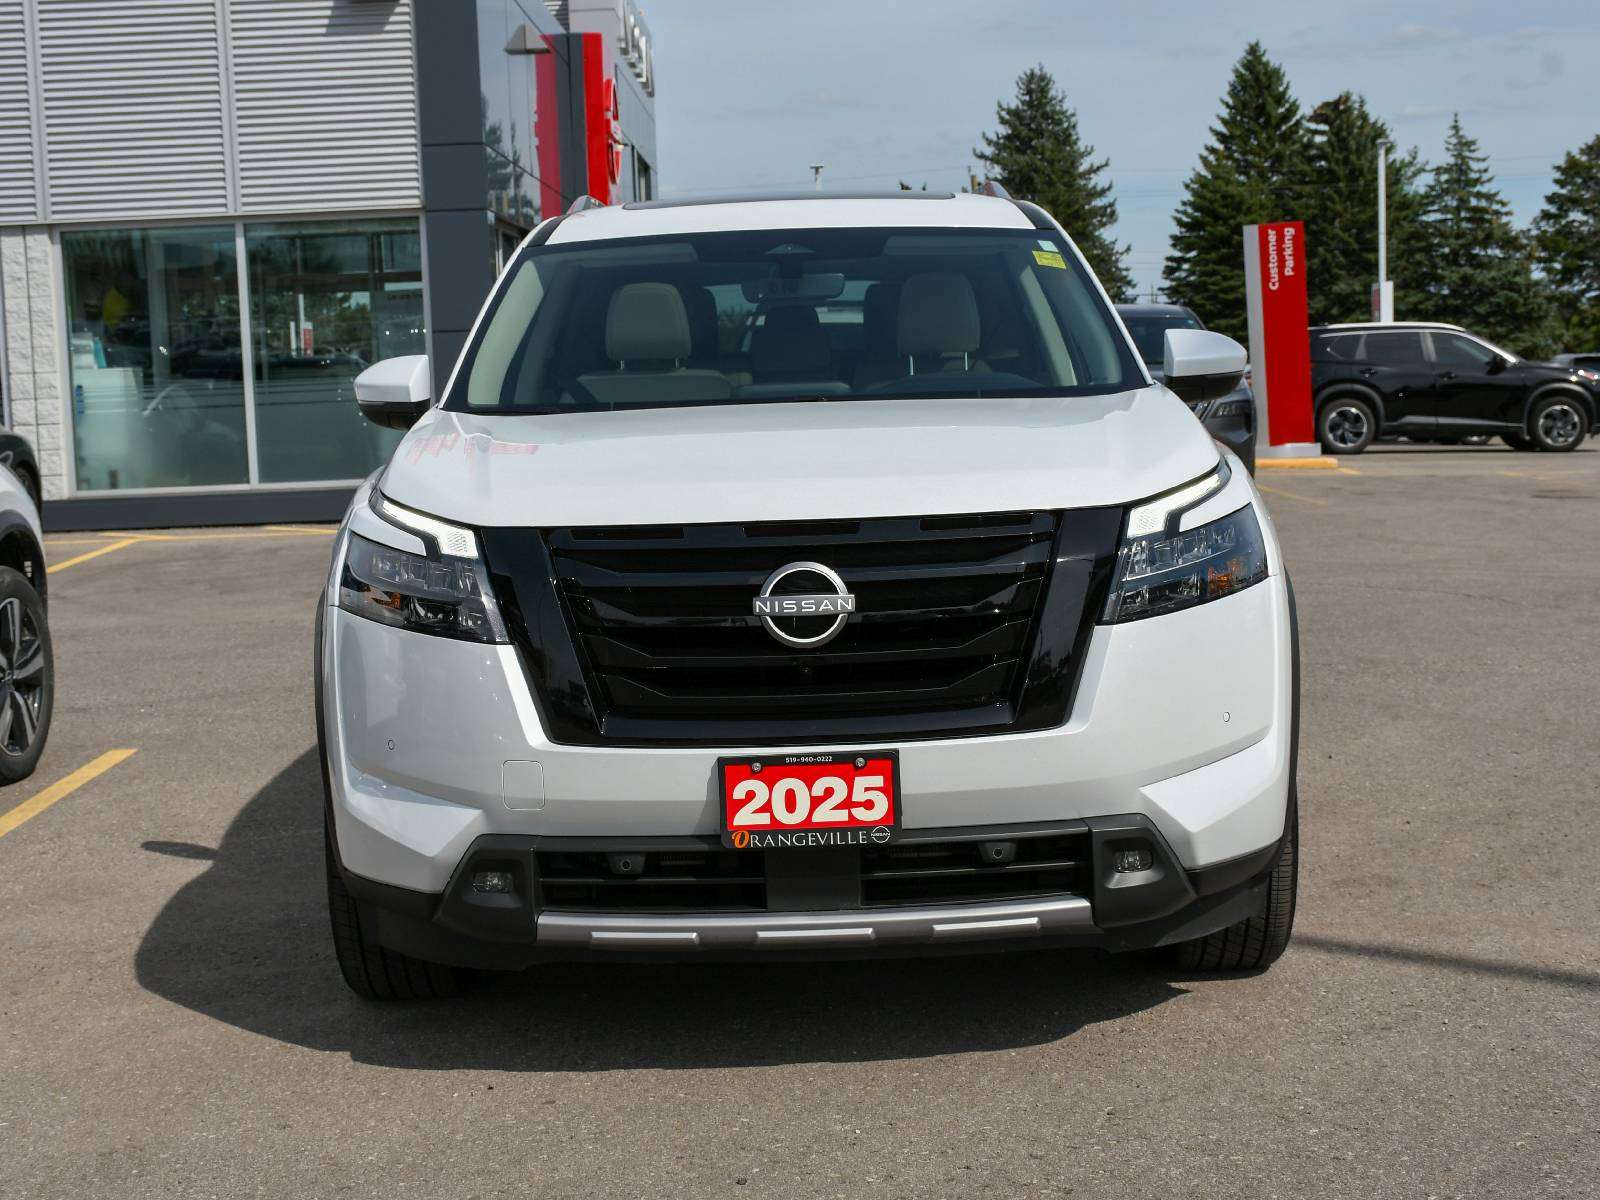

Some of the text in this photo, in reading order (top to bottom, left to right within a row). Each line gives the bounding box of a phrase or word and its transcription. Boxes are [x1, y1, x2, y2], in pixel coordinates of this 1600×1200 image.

[1268, 229, 1279, 290] Customer
[1283, 227, 1295, 276] Parking
[755, 598, 852, 613] NISSAN
[732, 776, 889, 826] 2025
[731, 830, 867, 848] ORANGEVILLE
